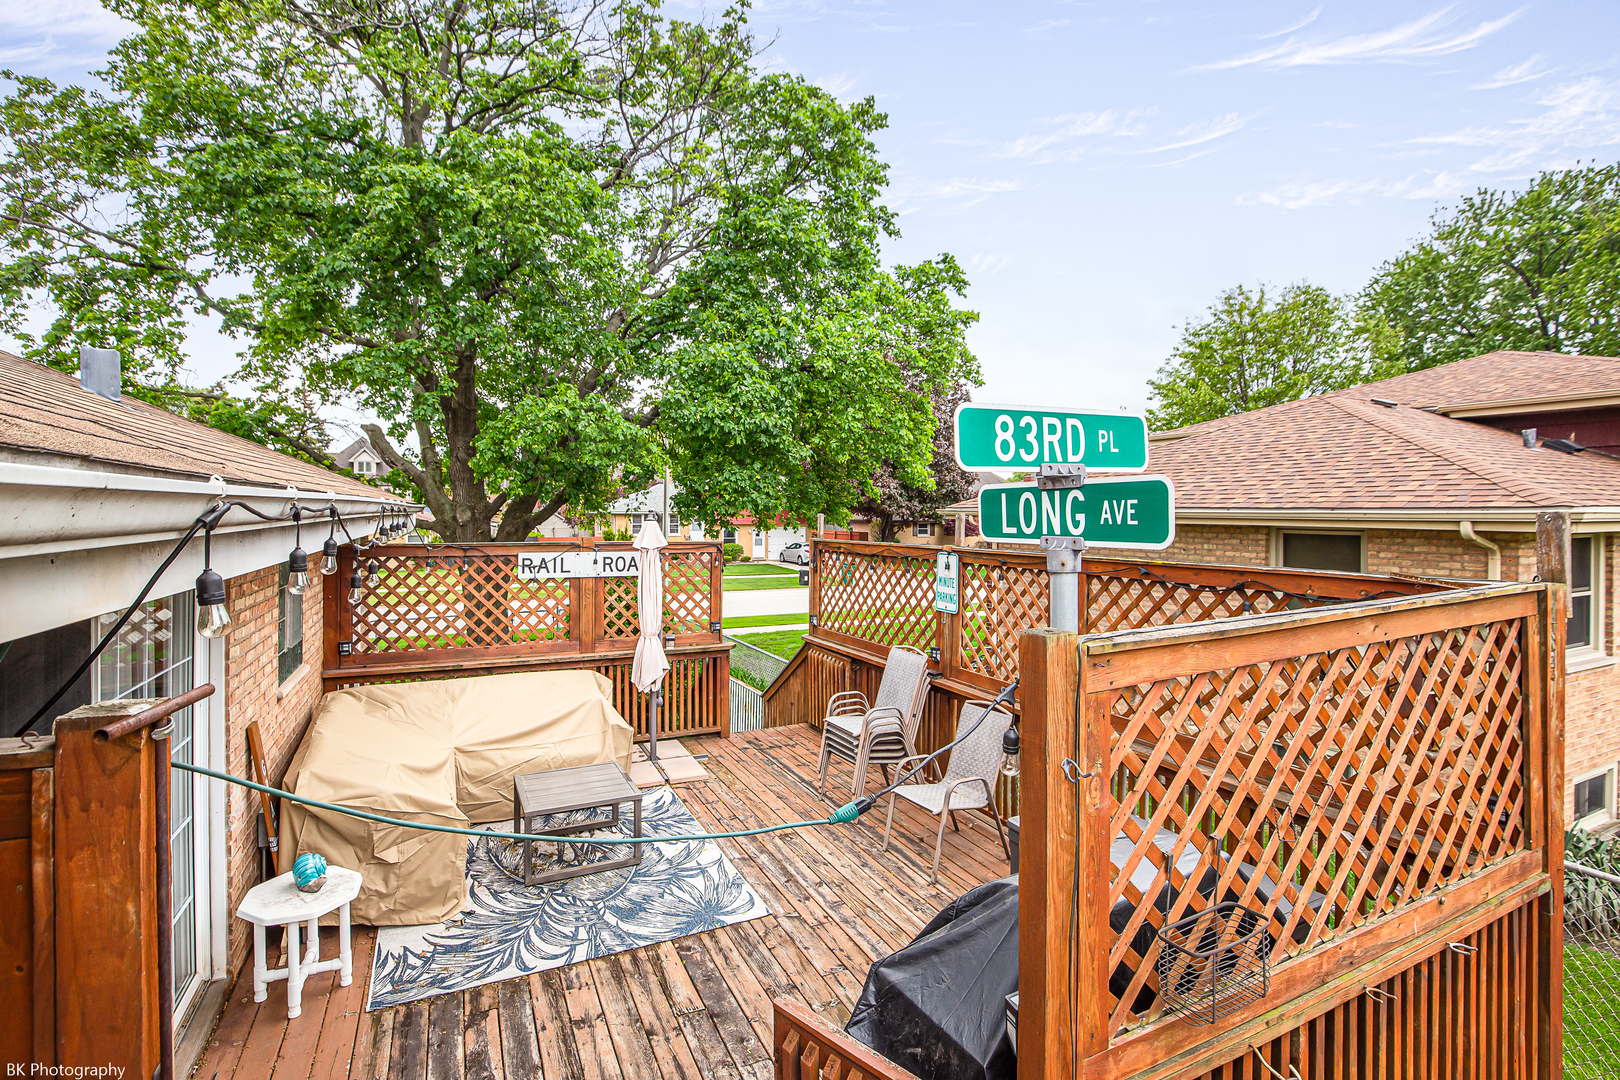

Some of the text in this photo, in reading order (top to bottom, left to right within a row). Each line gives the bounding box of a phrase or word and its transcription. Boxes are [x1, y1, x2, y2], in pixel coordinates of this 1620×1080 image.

[994, 414, 1119, 462] 83RD PL
[1001, 490, 1138, 536] LONG AVE
[521, 556, 639, 574] RAIL ROA
[938, 576, 955, 589] MINUTE
[937, 591, 956, 605] PARKING
